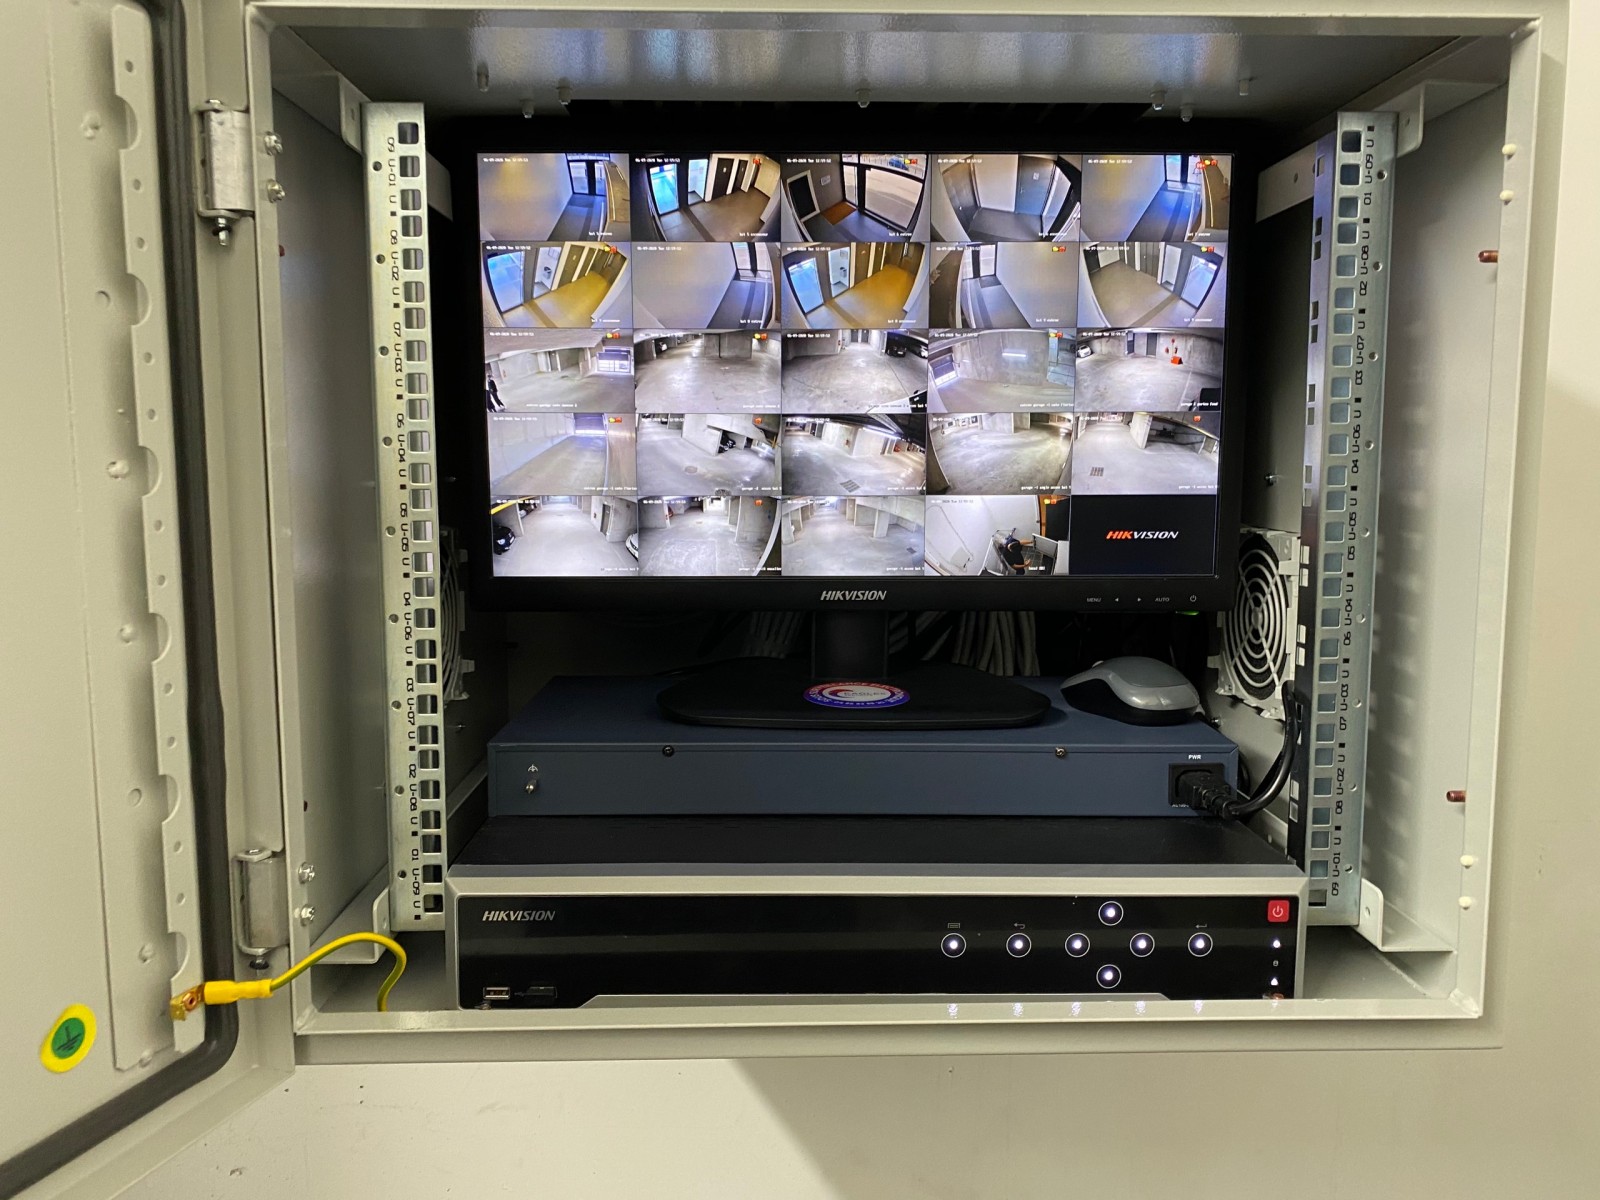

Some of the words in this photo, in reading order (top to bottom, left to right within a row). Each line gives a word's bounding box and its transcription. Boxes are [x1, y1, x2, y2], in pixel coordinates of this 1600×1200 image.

[1106, 531, 1179, 539] HIKVISION
[820, 590, 887, 600] HIKVISION
[482, 910, 556, 921] HIKVISION
